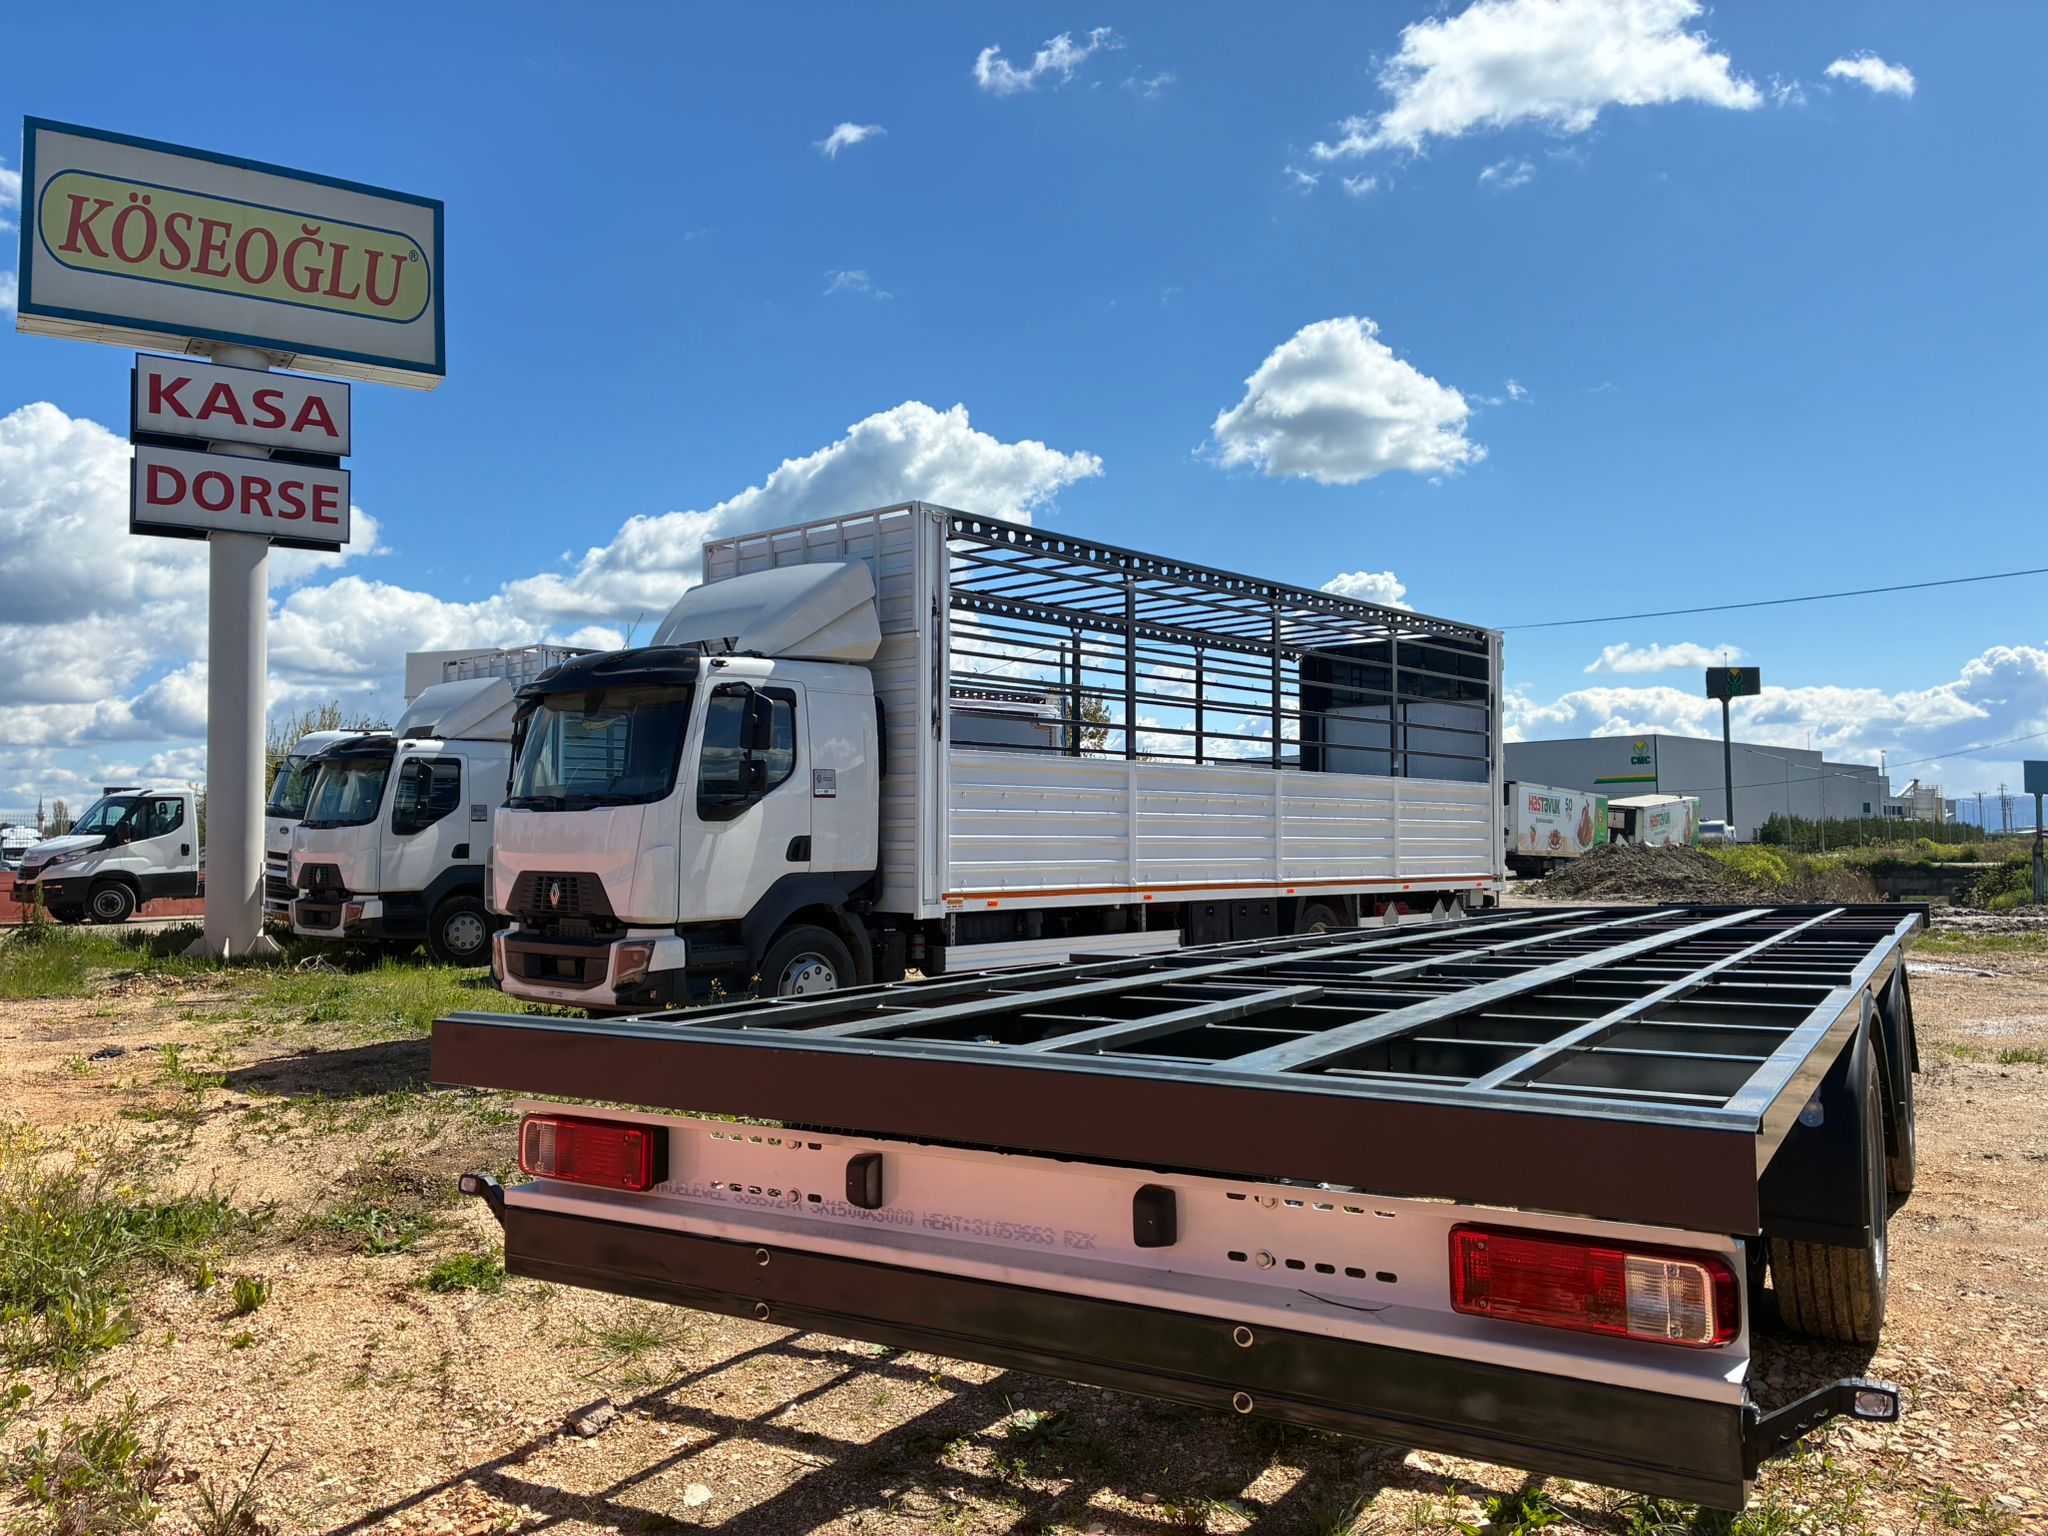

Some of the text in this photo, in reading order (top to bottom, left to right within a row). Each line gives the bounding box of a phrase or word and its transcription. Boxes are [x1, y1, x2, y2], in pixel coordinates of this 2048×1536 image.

[58, 192, 407, 306] KÖSEOĞLU
[148, 373, 340, 438] KASA
[146, 464, 340, 525] DORSE
[1630, 755, 1651, 765] CMC
